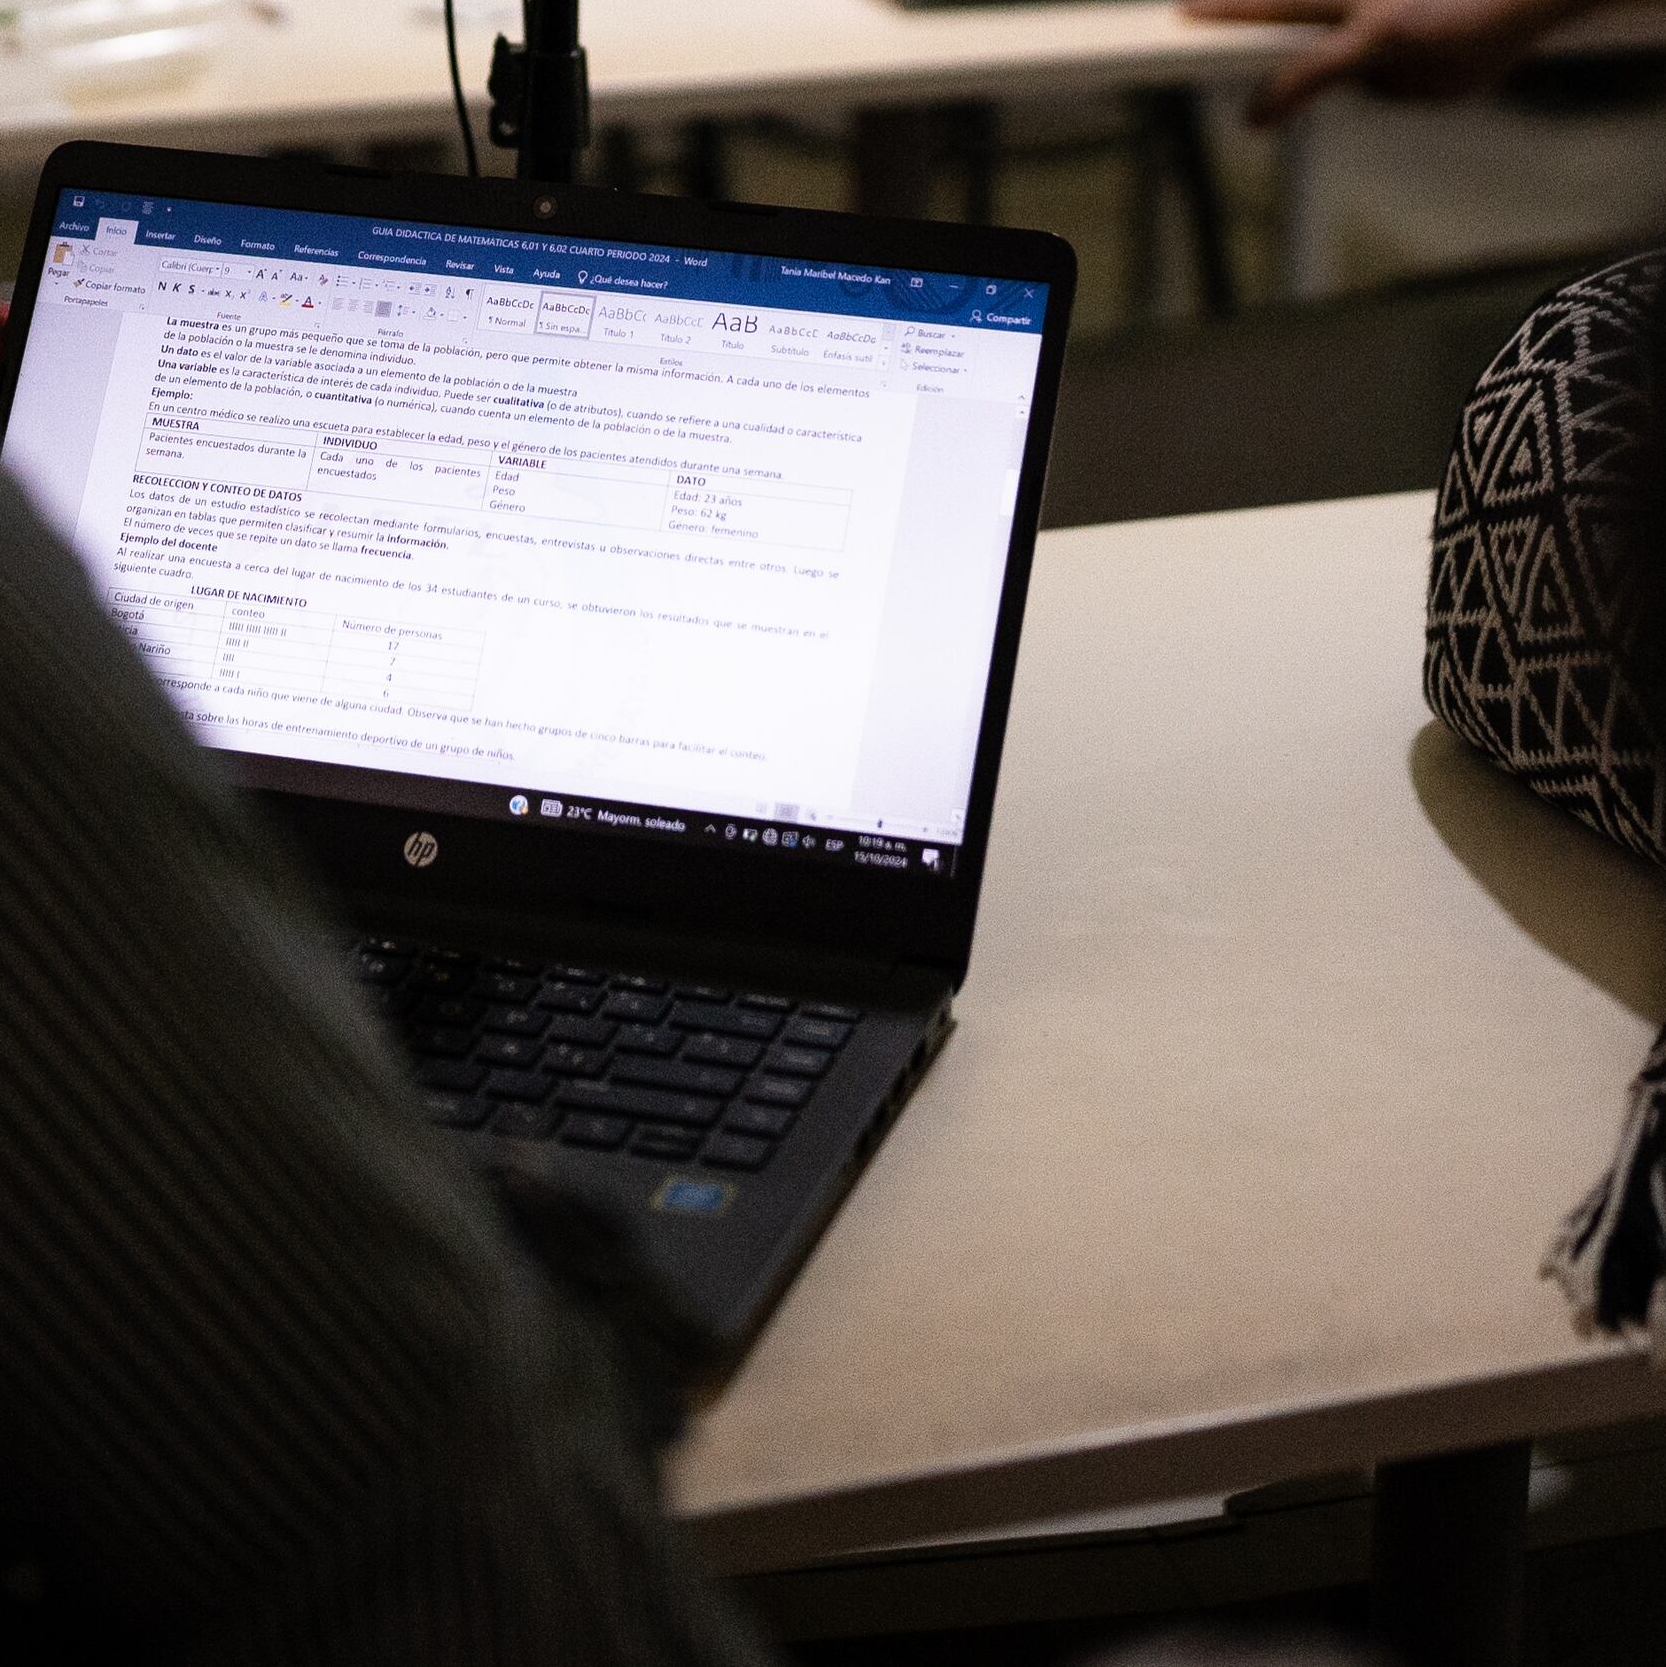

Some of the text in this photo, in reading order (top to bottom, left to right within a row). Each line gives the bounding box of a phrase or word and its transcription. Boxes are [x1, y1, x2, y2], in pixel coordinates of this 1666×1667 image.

[58, 221, 90, 232] Archivo
[105, 225, 128, 236] Inicio
[145, 229, 176, 240] Insertar
[193, 234, 223, 246] Diseño
[240, 239, 276, 251] Formato
[293, 244, 339, 257] Referencias
[371, 226, 394, 237] GUIA
[443, 233, 457, 243] DE
[541, 242, 548, 251] Y
[569, 245, 605, 257] CUARTO
[606, 248, 648, 261] PERIODO
[648, 252, 671, 264] 2024
[684, 256, 708, 267] Word
[357, 250, 427, 266] Correspondencia
[445, 259, 475, 271] Revisar
[47, 266, 70, 279] Pegar
[494, 264, 515, 275] Vista
[532, 268, 561, 280] Ayuda
[781, 265, 892, 285] Tania Maribel Macedo Kan
[85, 279, 146, 294] Copiar formato
[589, 274, 669, 290] ¿Qué desea hacer?
[63, 295, 109, 307] Portapapeles
[216, 311, 242, 321] Fuente
[711, 312, 758, 334] AaB
[986, 312, 1032, 326] Compartir
[917, 328, 946, 339] Buscar
[166, 316, 870, 399] La muestra es un grupo más pequeño que se toma de la población, pero que permite obtener la misma información. A cada uno de los elementos
[914, 345, 965, 358] Reemplazar
[160, 344, 578, 398] Un dato es el valor de la variable asociada a un elemento de la población o de la muestra
[912, 361, 960, 374] Seleccionar
[151, 386, 194, 400] Ejemplo:
[151, 417, 200, 431] MUESTRA
[148, 431, 307, 459] Pacientes encuestados durante la
[322, 436, 378, 451] INDIVIDUO
[145, 447, 184, 459] semana.
[319, 451, 481, 478] Cada uno de los pacientes
[498, 455, 546, 469] VARIABLE
[317, 467, 377, 481] encuestados
[495, 470, 520, 482] Edad
[676, 475, 707, 487] DATO
[132, 474, 302, 502] RECOLECCION Y CONTEO DE DATOS
[492, 484, 516, 496] Peso
[489, 500, 526, 513] Género
[119, 532, 218, 552] Ejemplo del docente
[123, 517, 412, 560] El número de veces que se repite un dato se llama frecuencia.
[114, 591, 194, 612] Ciudad de origen
[190, 585, 308, 608] LUGAR DE NACIMIENTO
[111, 608, 145, 623] Bogotá
[231, 608, 266, 619] conteo
[139, 642, 171, 655] Nariño
[388, 641, 400, 651] 17
[566, 805, 686, 832] 23°C Mayorm. soleado
[404, 831, 438, 867] hp
